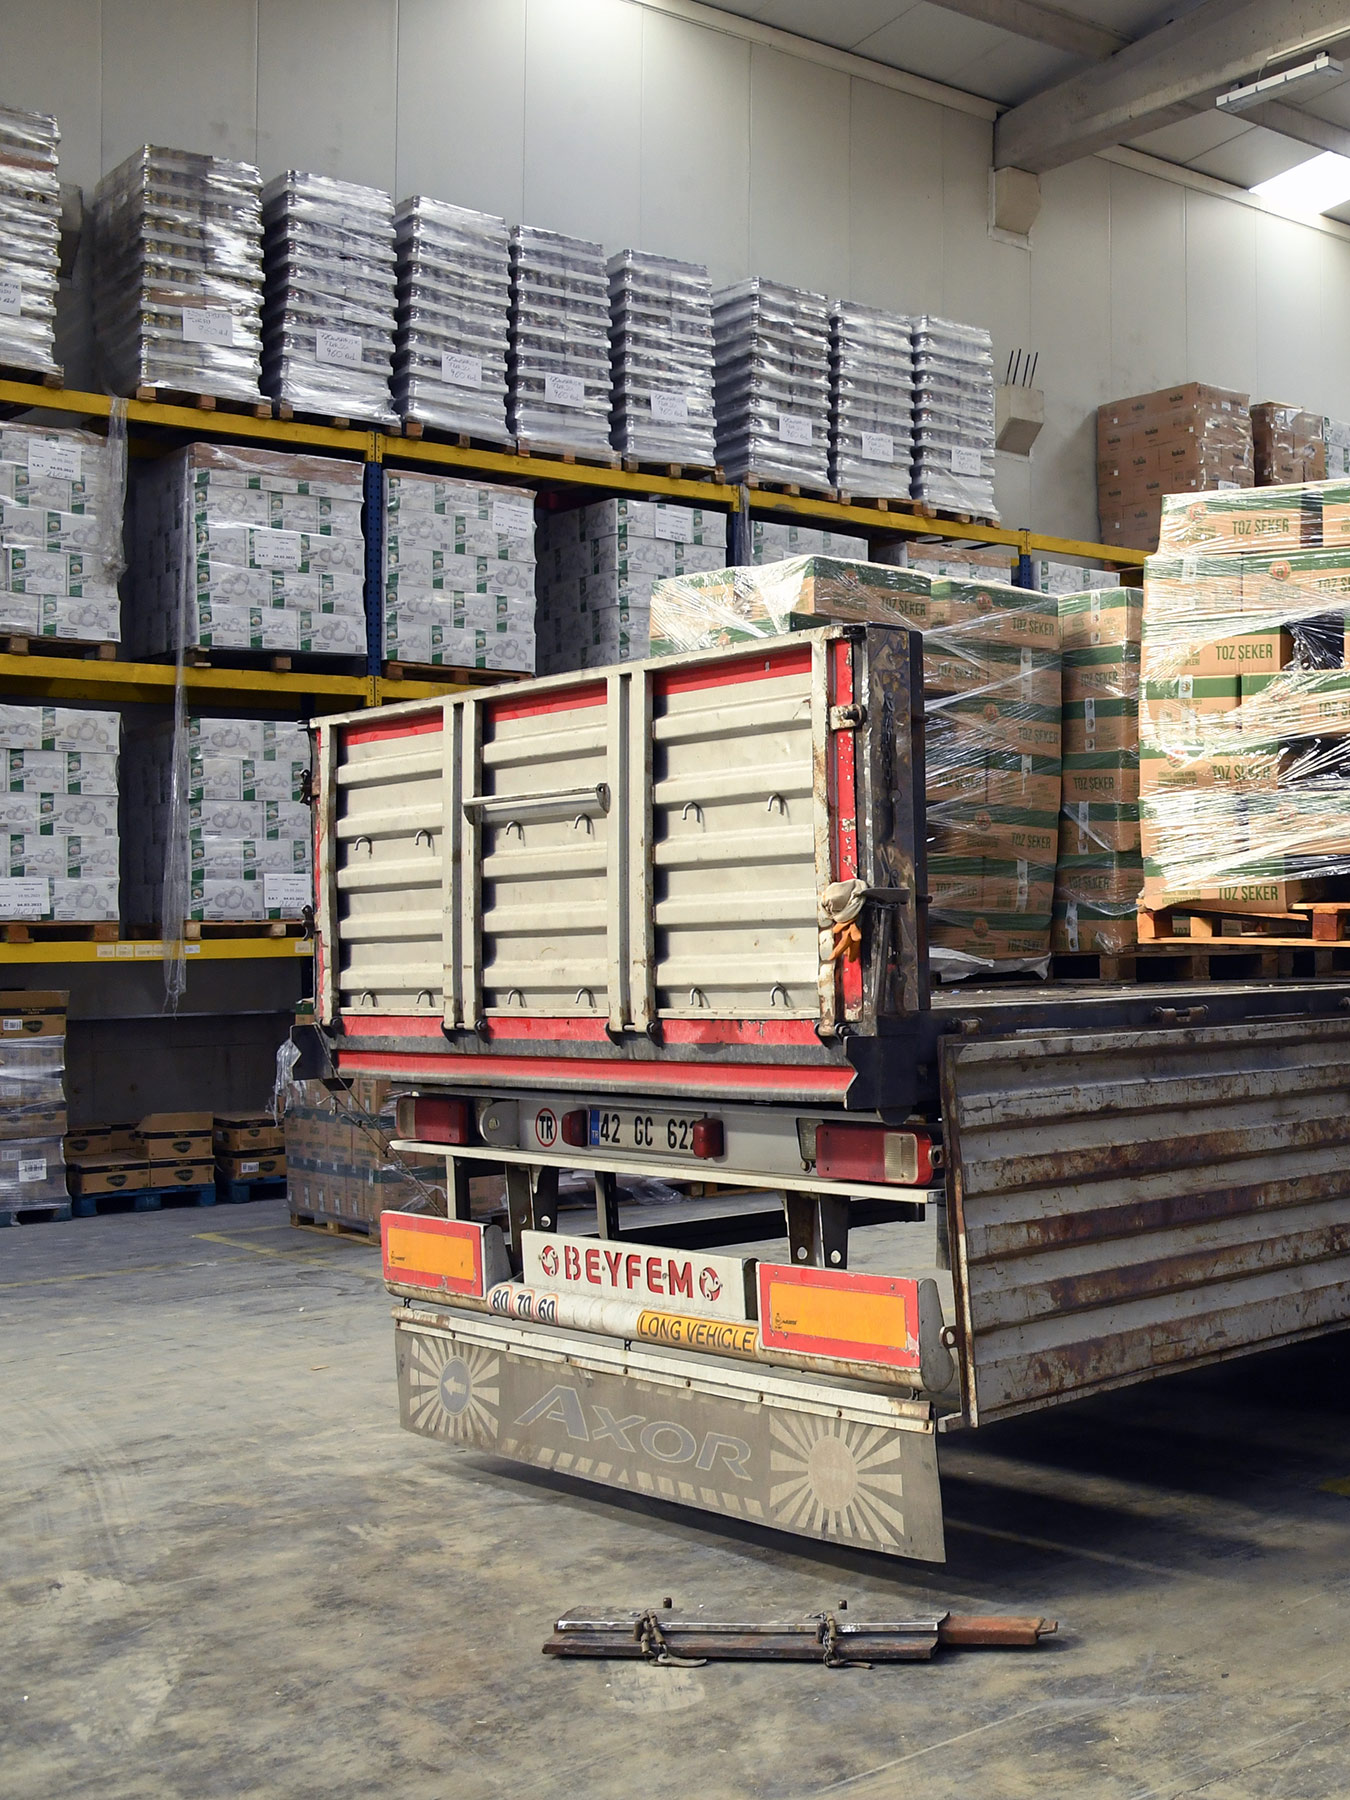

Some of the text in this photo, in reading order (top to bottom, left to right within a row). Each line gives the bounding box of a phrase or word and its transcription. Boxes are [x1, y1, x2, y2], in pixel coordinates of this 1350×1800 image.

[1232, 521, 1251, 535] TOZ
[1216, 644, 1273, 662] TOZ ŞEKER
[1073, 776, 1114, 792] TOZ ŞEKER
[1011, 832, 1025, 847] TOZ
[1241, 885, 1278, 903] ŞEKER
[539, 1115, 553, 1140] TR
[591, 1130, 599, 1139] TR
[600, 1113, 621, 1144] 42
[634, 1116, 654, 1146] GC
[564, 1245, 694, 1299] BEYFEM
[492, 1290, 556, 1324] 80 70 60
[640, 1316, 755, 1352] LONG VEHICLE
[513, 1384, 753, 1482] AXOR
